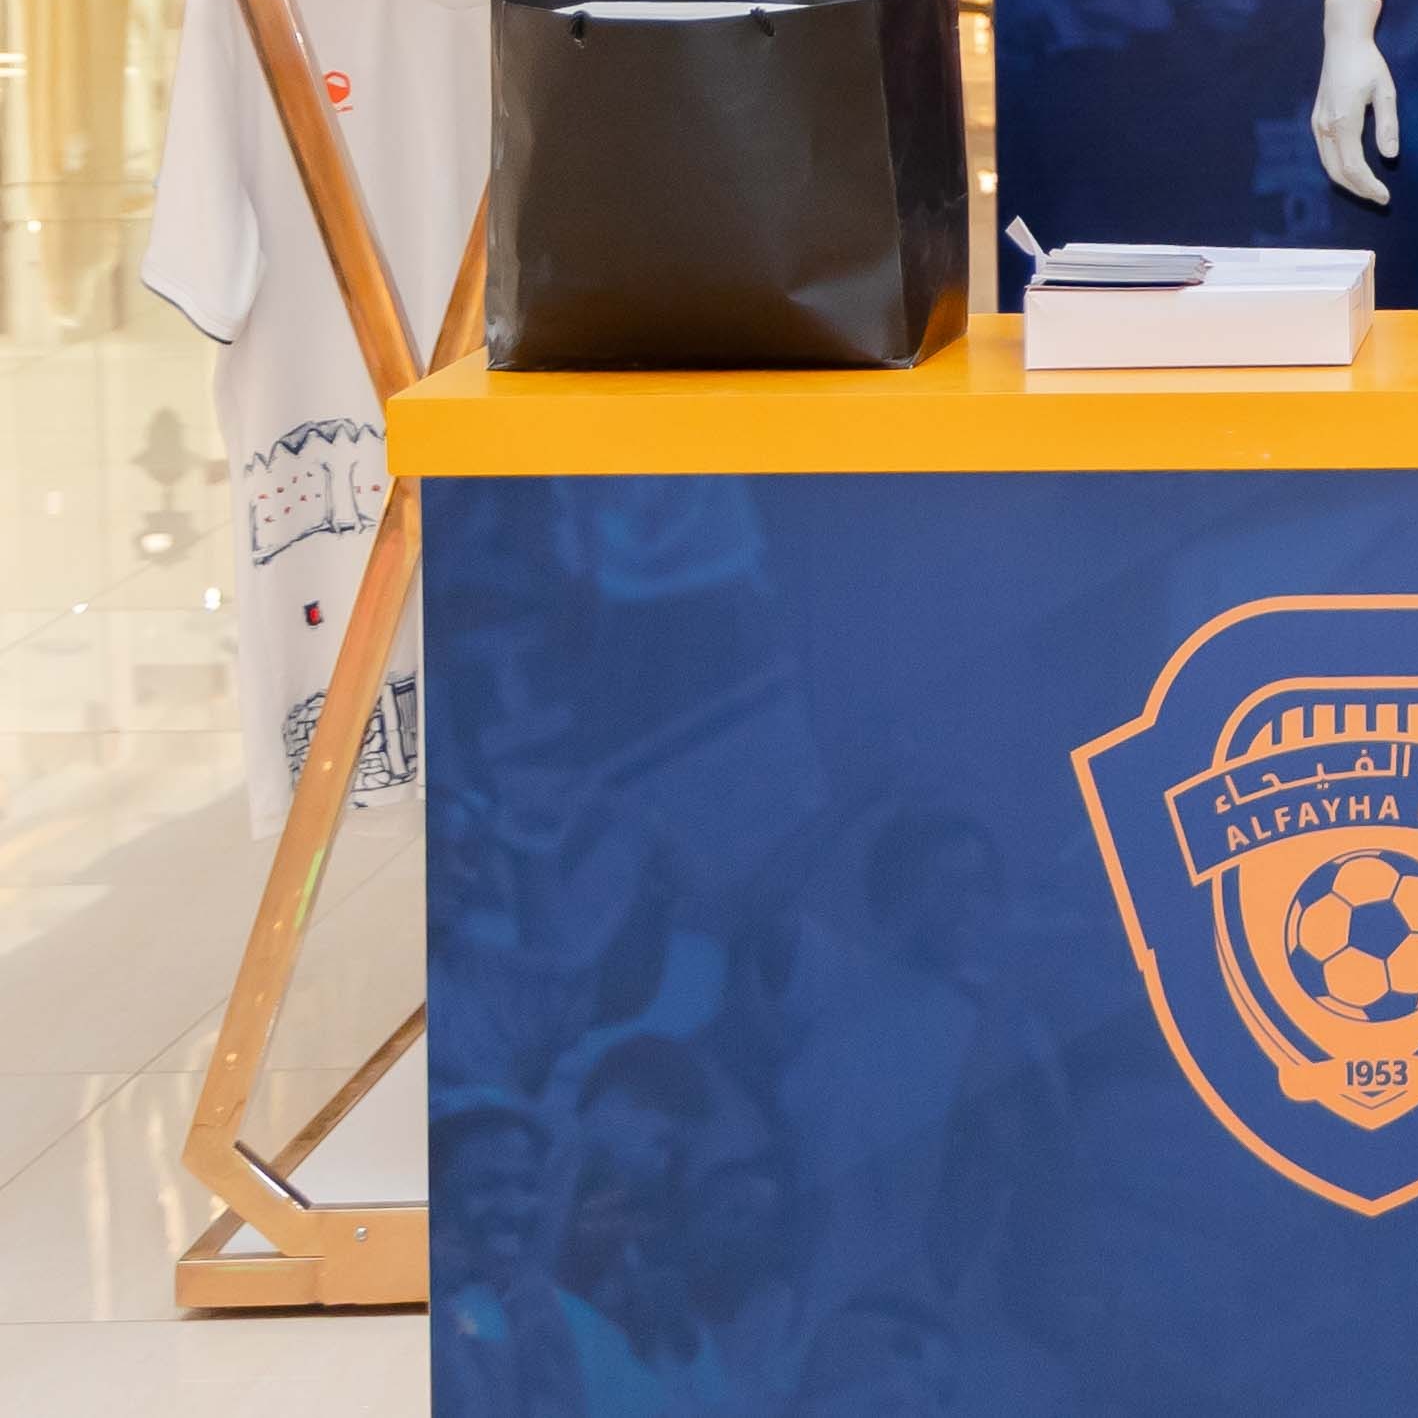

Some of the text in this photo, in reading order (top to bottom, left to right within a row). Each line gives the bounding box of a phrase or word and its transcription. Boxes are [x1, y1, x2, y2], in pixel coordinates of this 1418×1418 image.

[1214, 743, 1411, 814] الفيحاء
[1225, 795, 1400, 852] ALFAYHA
[1345, 1060, 1409, 1087] 1953
